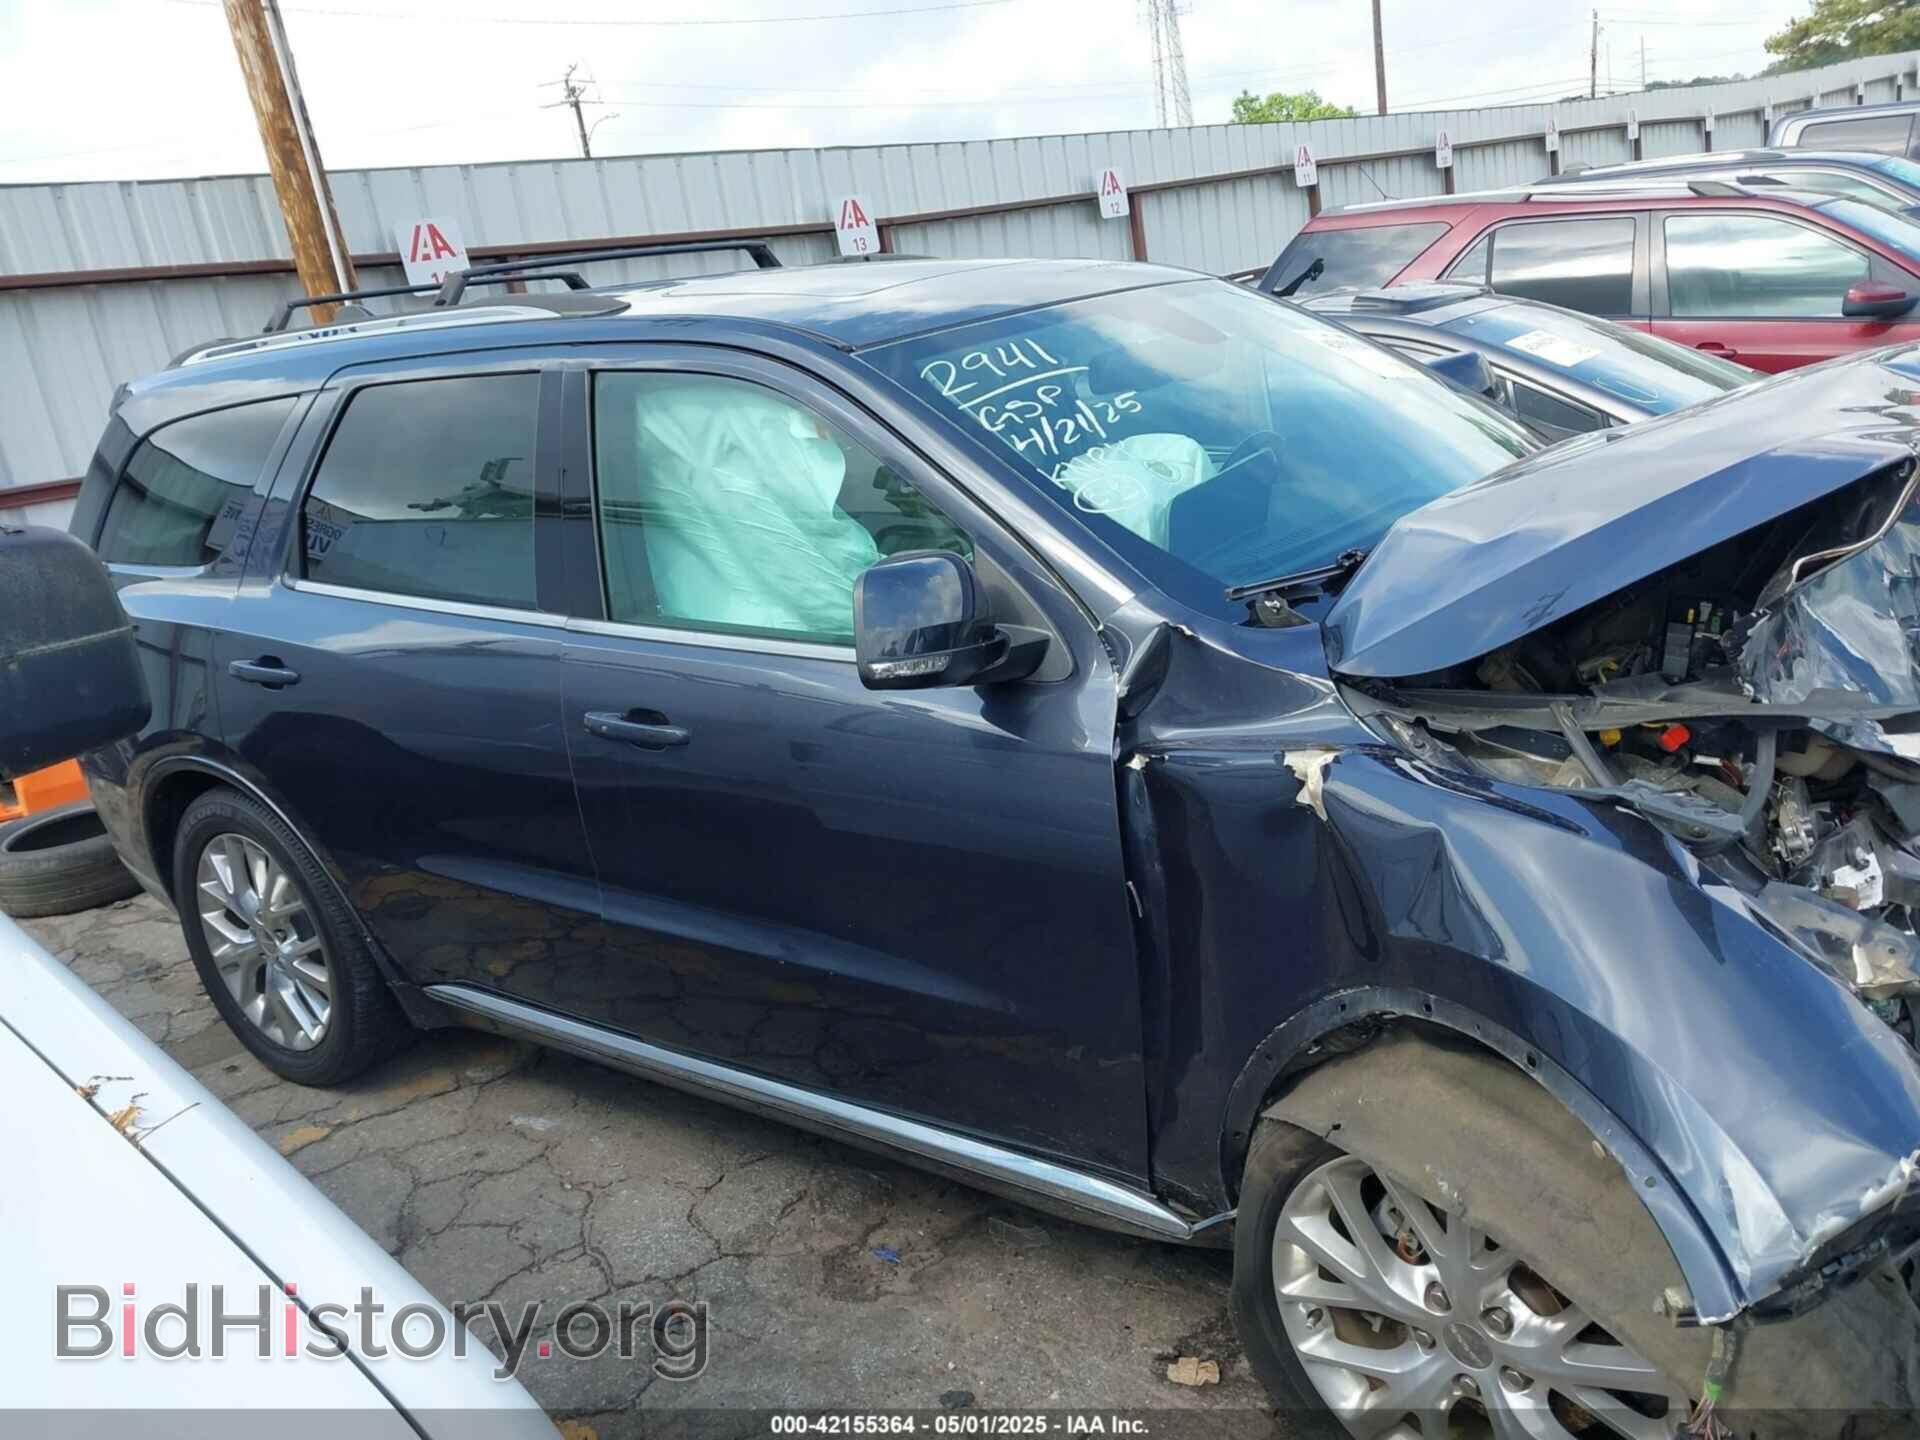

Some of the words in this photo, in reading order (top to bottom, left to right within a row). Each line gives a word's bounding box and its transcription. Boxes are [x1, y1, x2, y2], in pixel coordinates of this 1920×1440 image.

[1110, 203, 1121, 214] 12
[853, 237, 868, 251] 13
[920, 338, 1059, 396] 2941
[979, 384, 1062, 433] GSP
